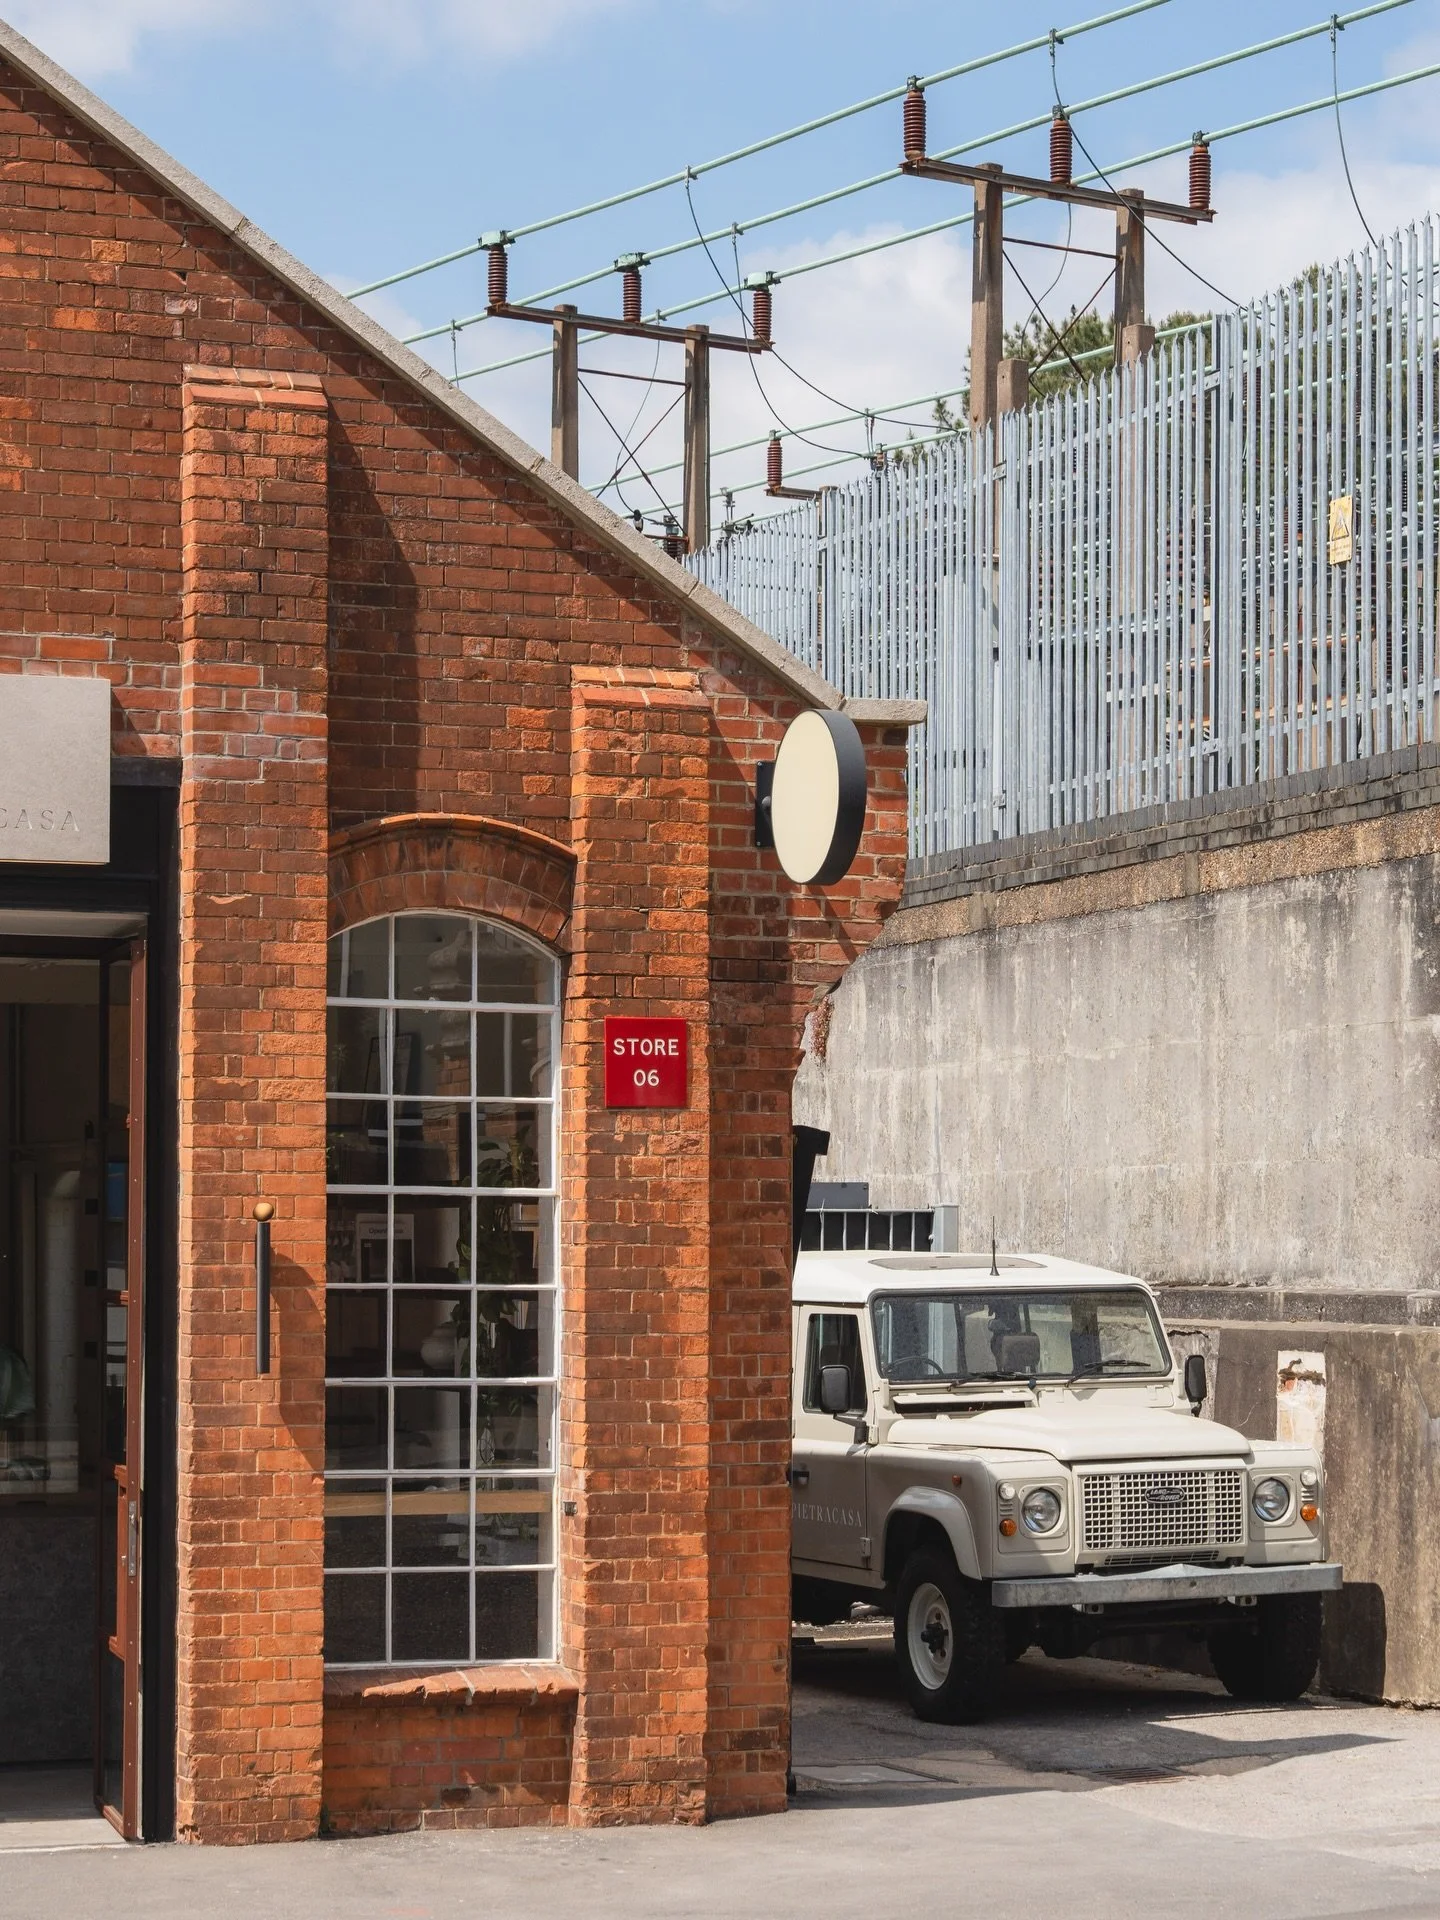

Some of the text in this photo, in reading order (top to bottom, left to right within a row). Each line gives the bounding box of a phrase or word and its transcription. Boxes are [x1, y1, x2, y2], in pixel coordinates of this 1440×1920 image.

[613, 1038, 679, 1056] STORE
[633, 1069, 660, 1087] 06
[791, 1502, 862, 1527] PIETRACASA
